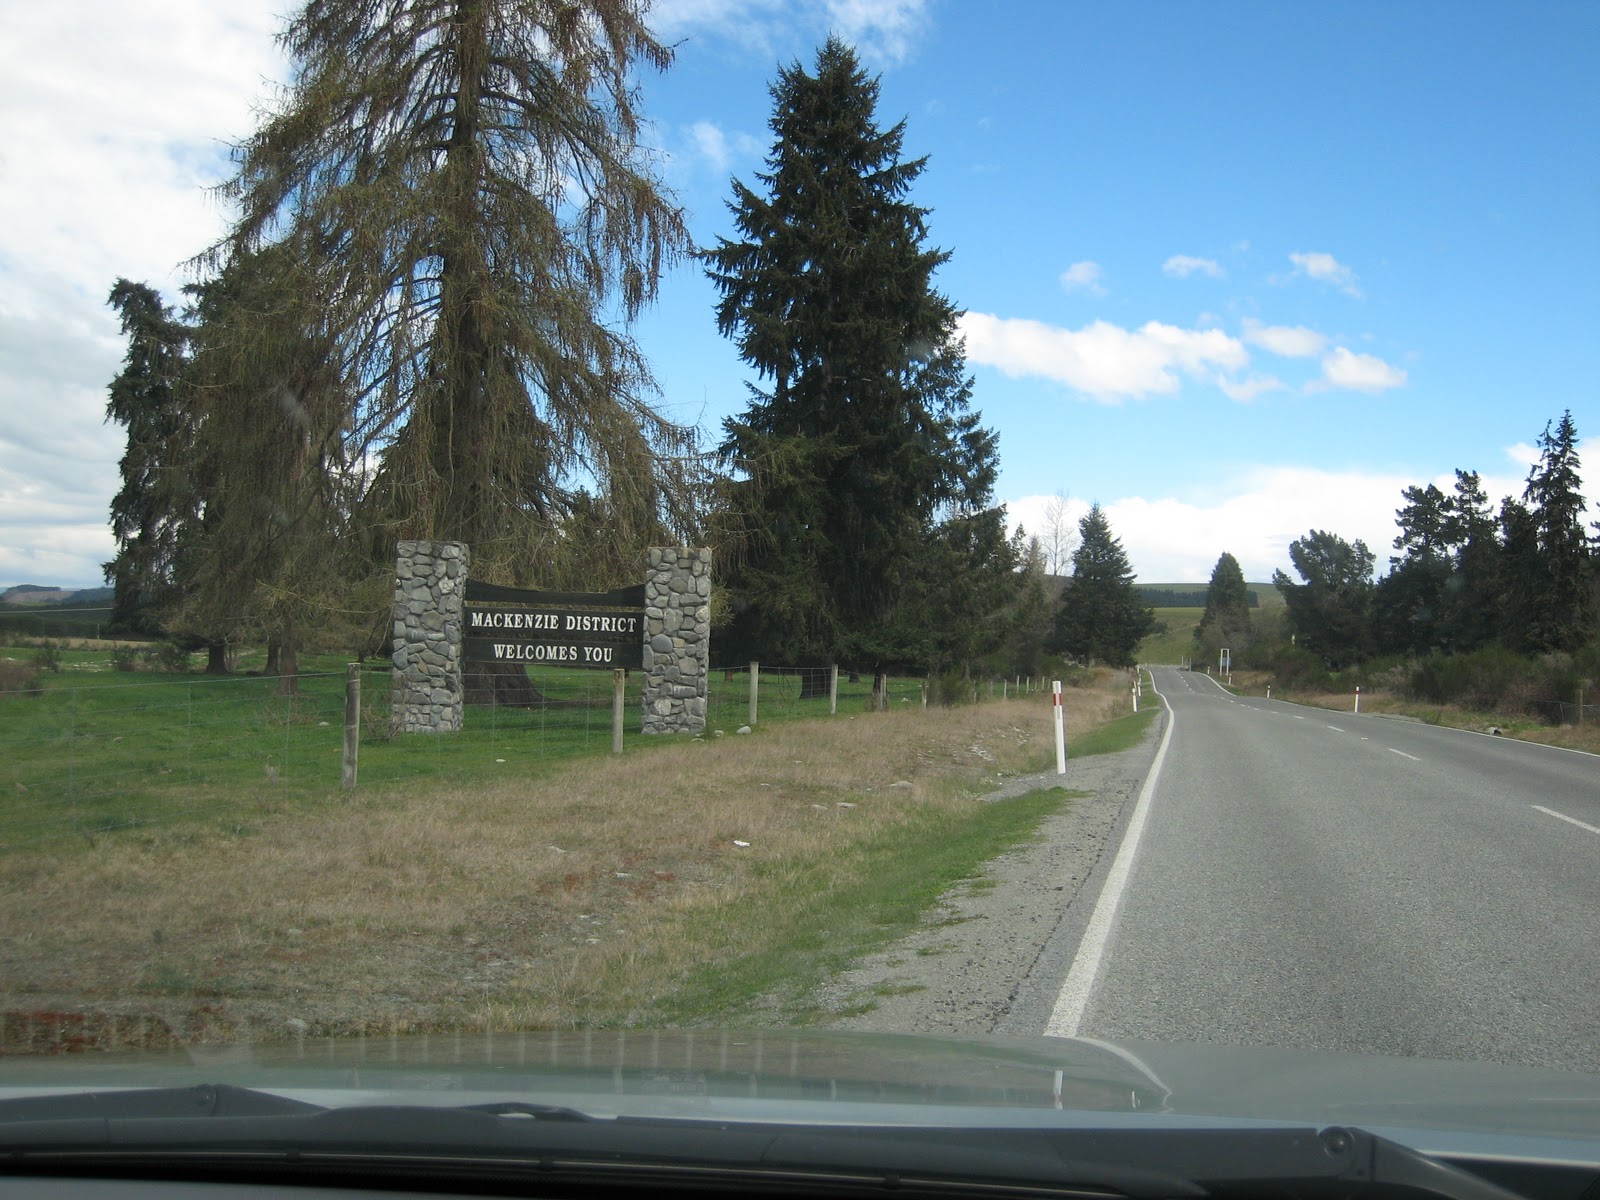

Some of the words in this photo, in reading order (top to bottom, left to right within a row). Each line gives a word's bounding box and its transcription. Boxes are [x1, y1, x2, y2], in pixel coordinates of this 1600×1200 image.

[471, 612, 559, 630] MACKENZIE
[565, 615, 637, 633] DISTRICT
[493, 643, 578, 661] WELCOMES
[584, 646, 613, 663] YOU
